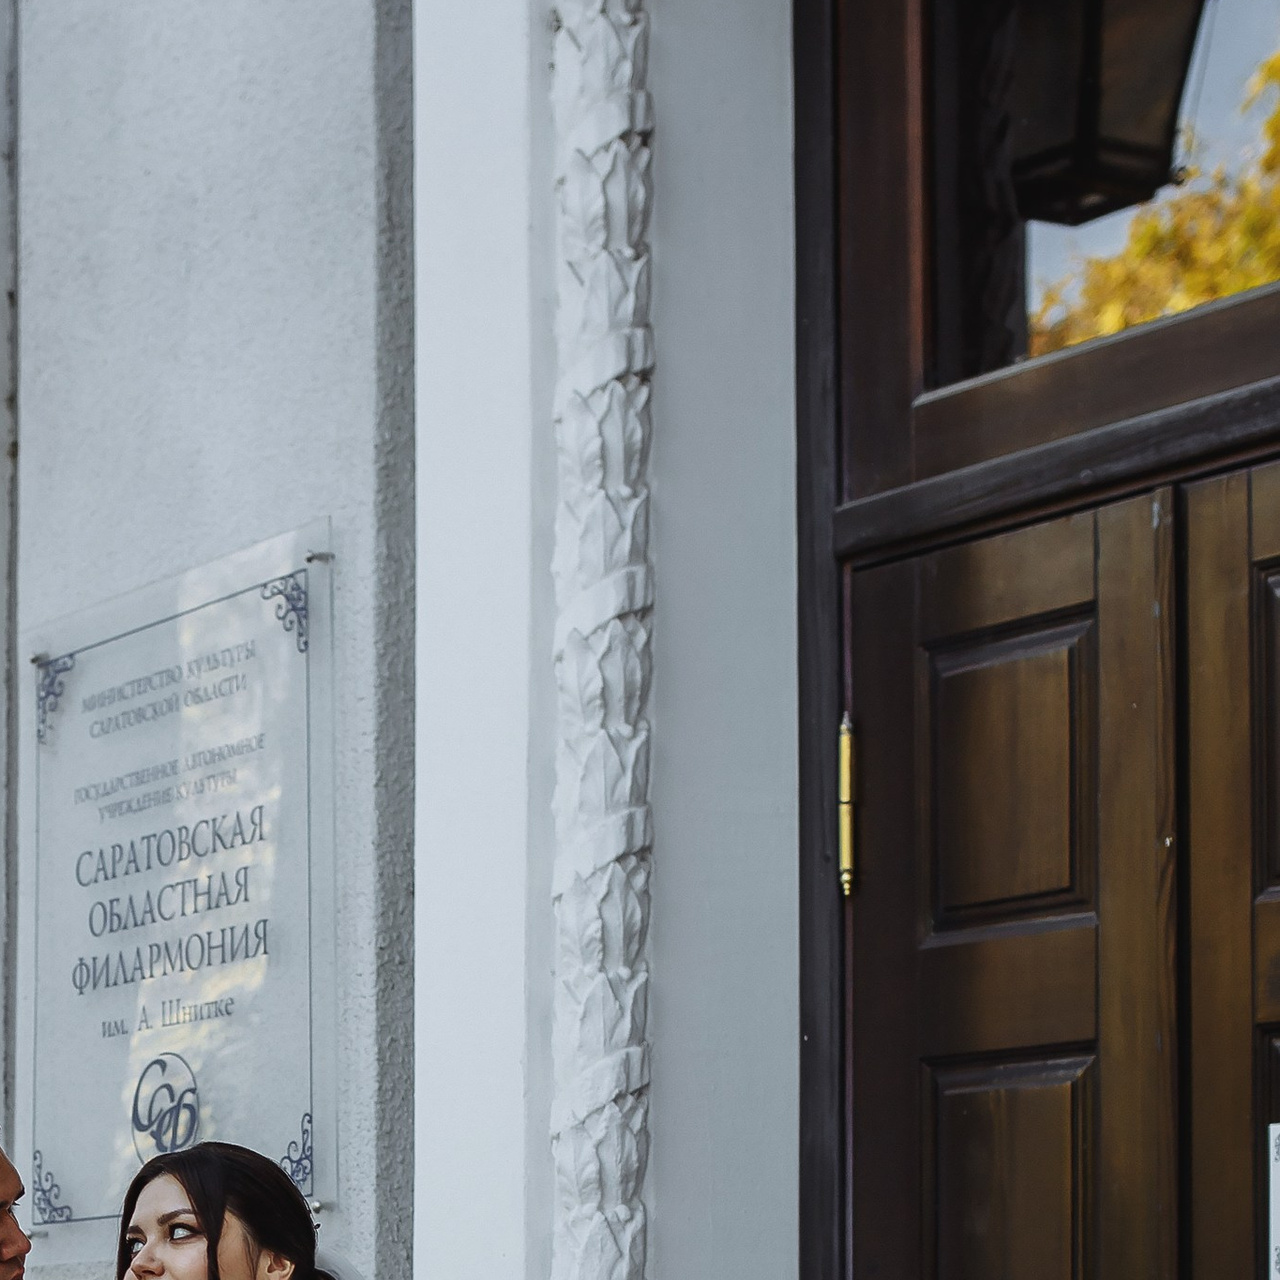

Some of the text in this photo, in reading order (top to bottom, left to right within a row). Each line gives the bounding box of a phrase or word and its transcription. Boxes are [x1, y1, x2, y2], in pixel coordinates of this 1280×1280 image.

[75, 805, 266, 887] САРАТОВСКАЯ
[88, 866, 250, 938] ОБЛАСТНАЯ
[72, 918, 269, 996] ФИЛАРМОНИЯ
[101, 1018, 129, 1039] им.
[161, 996, 235, 1028] Шнитке
